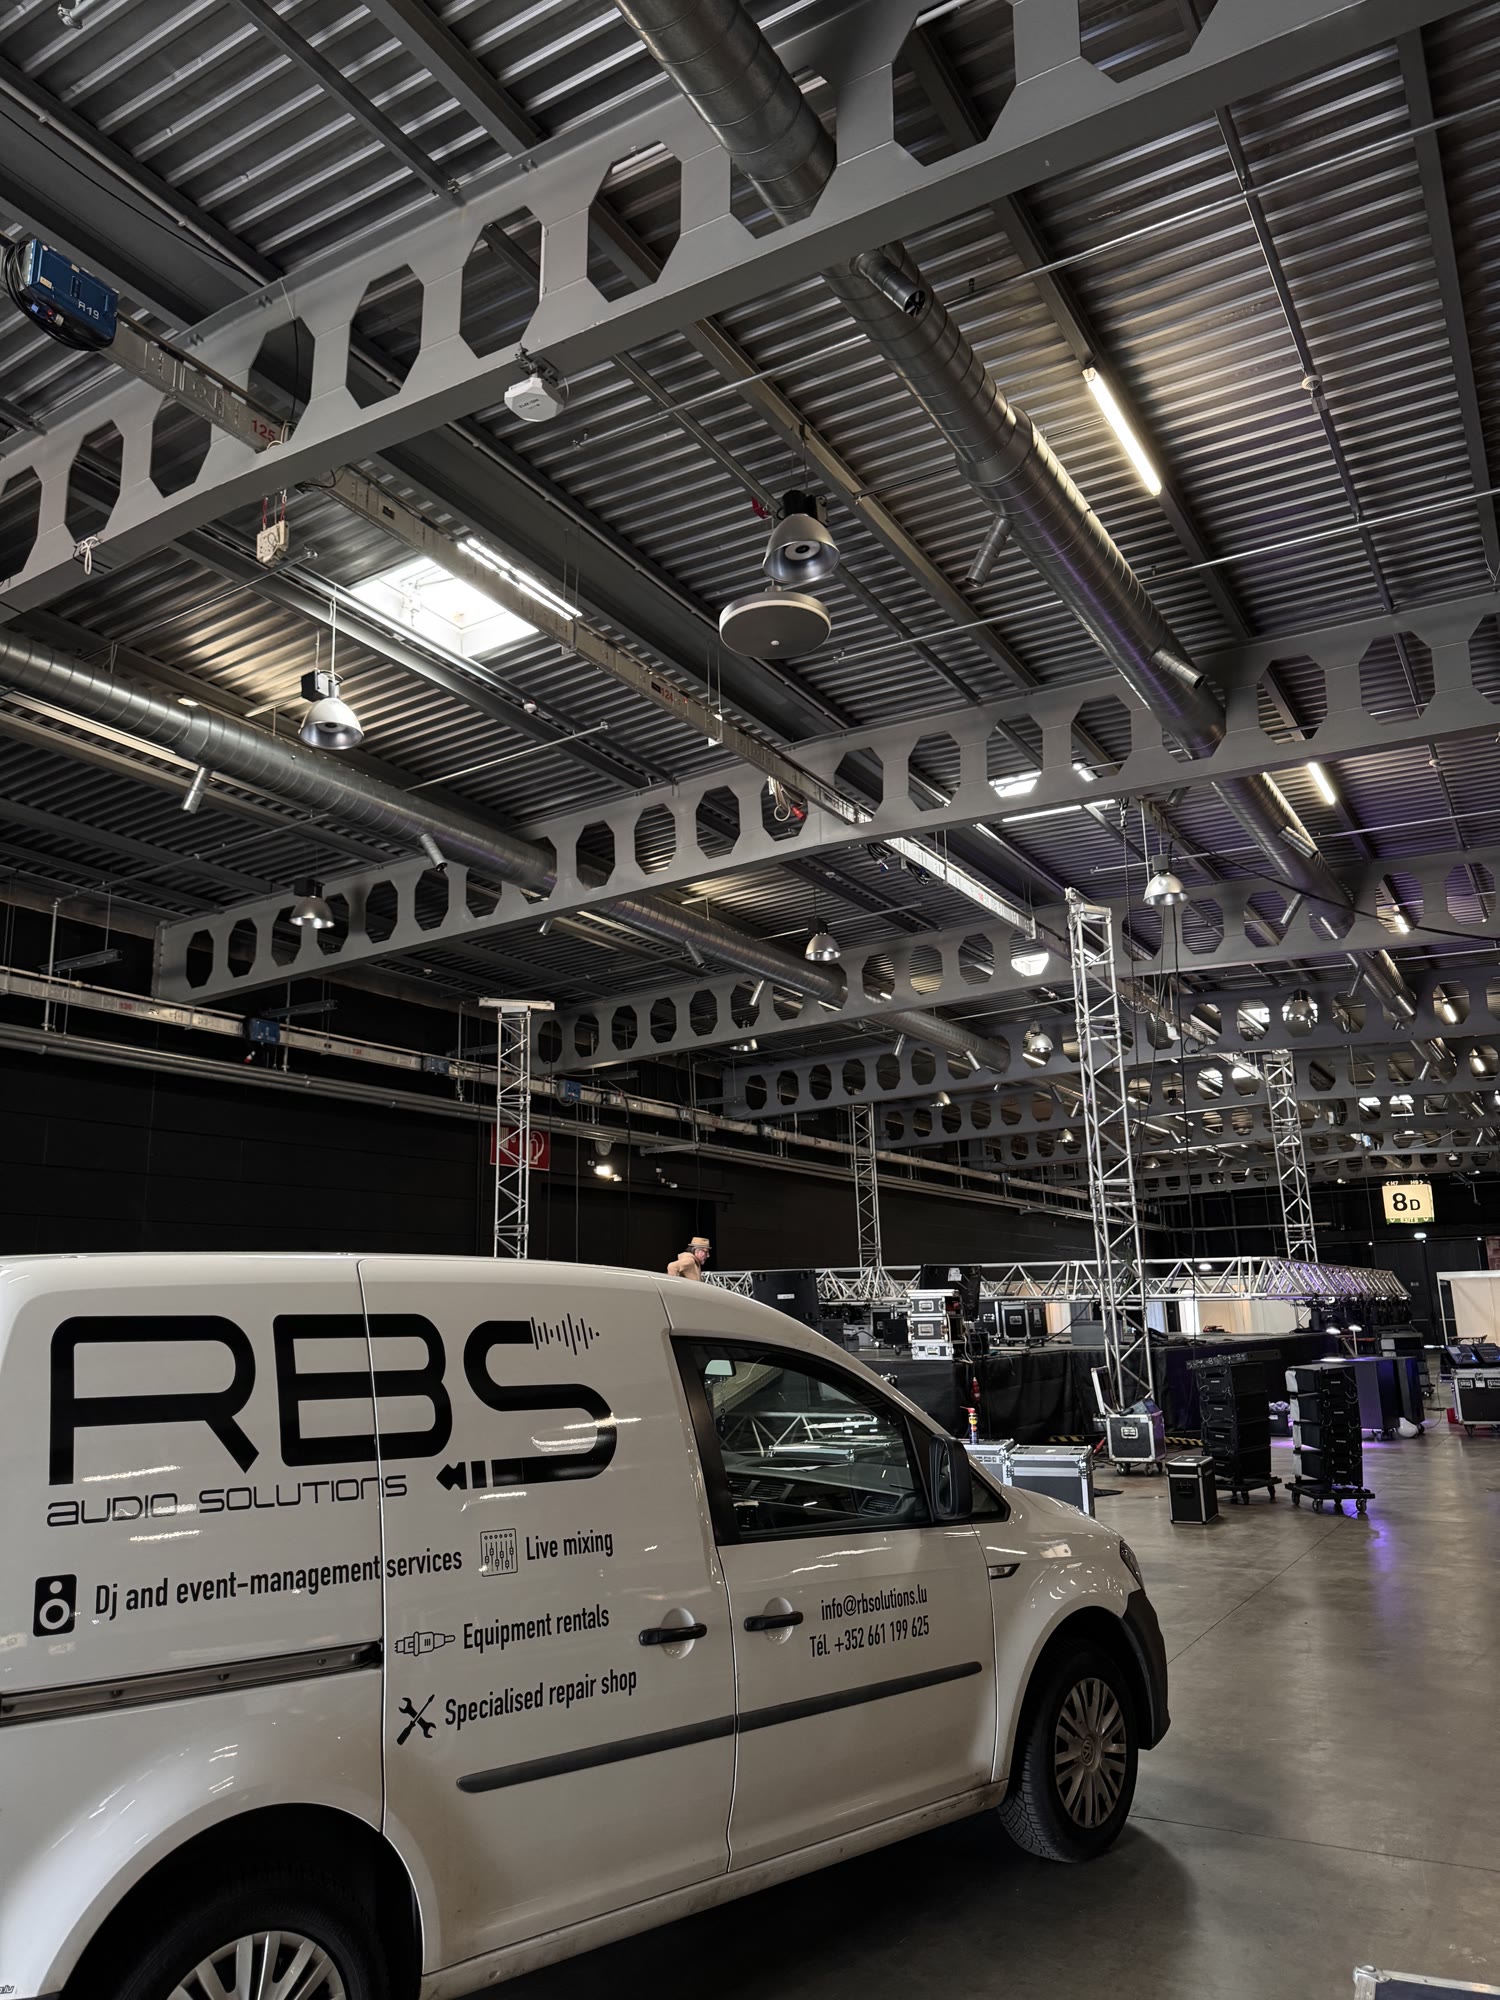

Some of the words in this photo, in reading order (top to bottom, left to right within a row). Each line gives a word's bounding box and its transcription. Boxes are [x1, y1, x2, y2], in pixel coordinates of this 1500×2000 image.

[252, 420, 276, 442] 125
[49, 1313, 618, 1490] RBS
[525, 1536, 559, 1561] Live
[562, 1530, 614, 1558] mixing
[95, 1583, 118, 1622] Dj
[126, 1577, 169, 1611] and
[176, 1555, 381, 1605] event-management
[386, 1548, 463, 1579] services
[820, 1584, 928, 1621] info@rbsolutions.lu
[463, 1612, 553, 1655] Equipment
[556, 1604, 610, 1635] rentals
[809, 1634, 831, 1658] Tél.
[834, 1627, 865, 1653] +352
[867, 1622, 886, 1647] 661
[889, 1618, 908, 1642] 199
[911, 1615, 930, 1638] 625
[444, 1682, 544, 1731] Specialised
[549, 1673, 598, 1709] repair
[601, 1669, 637, 1697] shop
